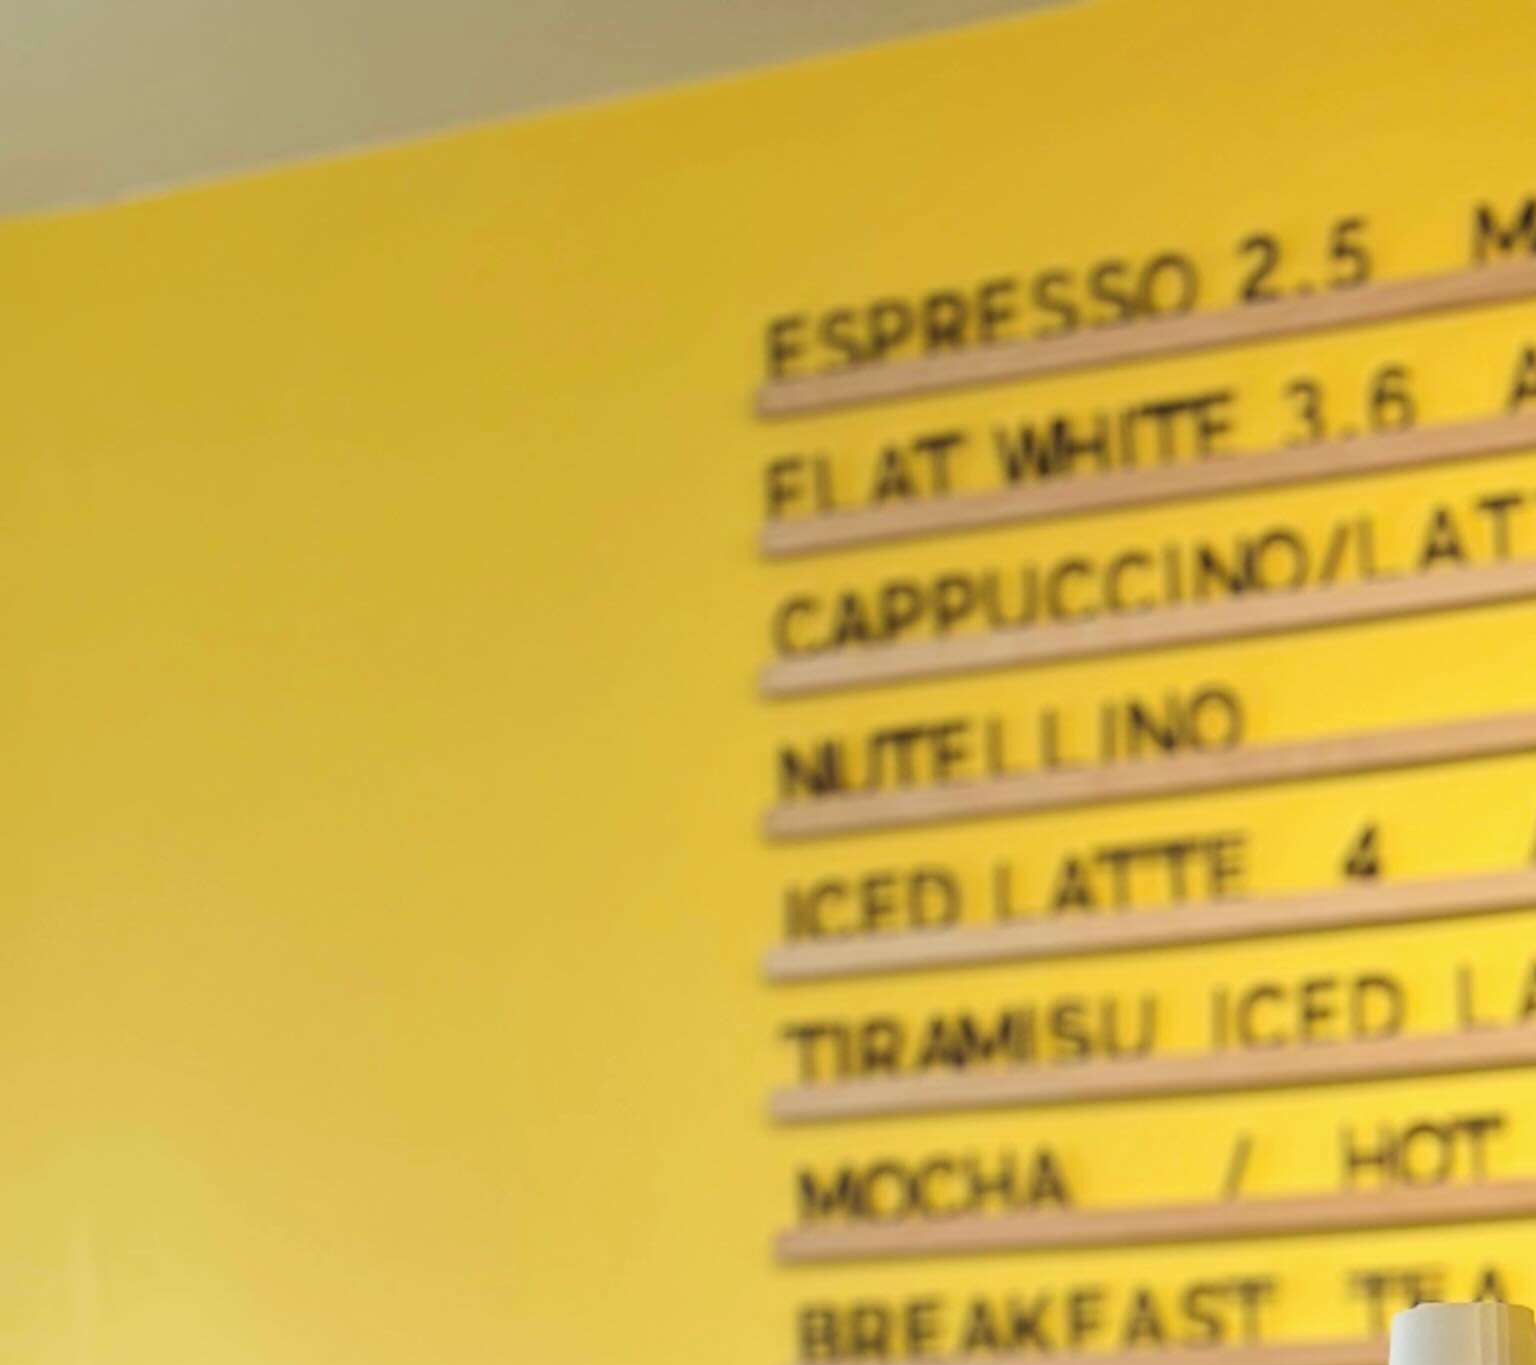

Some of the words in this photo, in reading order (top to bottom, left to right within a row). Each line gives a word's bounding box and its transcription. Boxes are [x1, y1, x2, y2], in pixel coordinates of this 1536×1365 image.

[764, 251, 1199, 381] ESPRESSO
[1236, 217, 1373, 304] 2.5
[766, 430, 968, 522] FLAT
[996, 391, 1235, 488] WHITE
[1284, 365, 1416, 447] 3.6
[779, 689, 1245, 798] NUTELLINO
[784, 863, 963, 944] ICED
[994, 832, 1247, 923] LATTE
[1342, 824, 1379, 880] 4
[784, 994, 1154, 1085] TIRAMISU
[1212, 975, 1402, 1049] ICED
[799, 1153, 1070, 1222] MOCHA
[1343, 1114, 1504, 1187] HOT
[799, 1278, 1275, 1363] BREAKFAST
